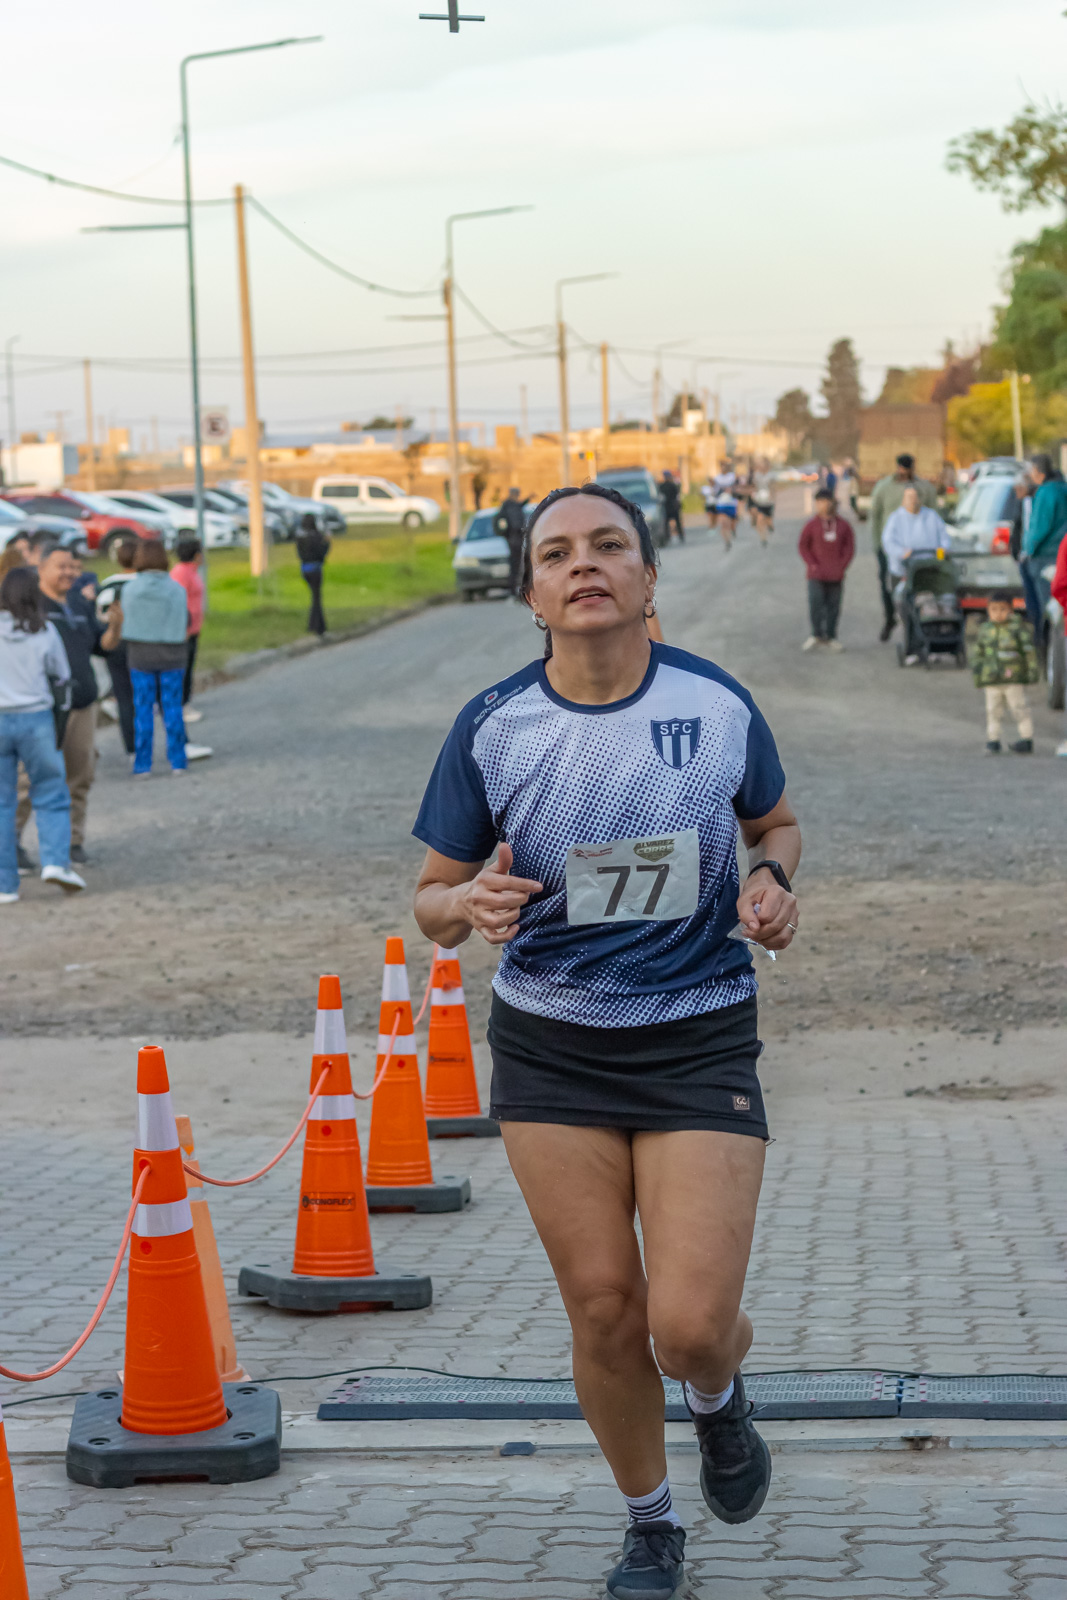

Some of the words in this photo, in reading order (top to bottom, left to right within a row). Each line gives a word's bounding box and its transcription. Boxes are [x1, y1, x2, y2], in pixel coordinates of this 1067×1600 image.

[660, 722, 692, 735] SFC
[634, 838, 675, 849] ALVAREZ
[597, 863, 669, 916] 77
